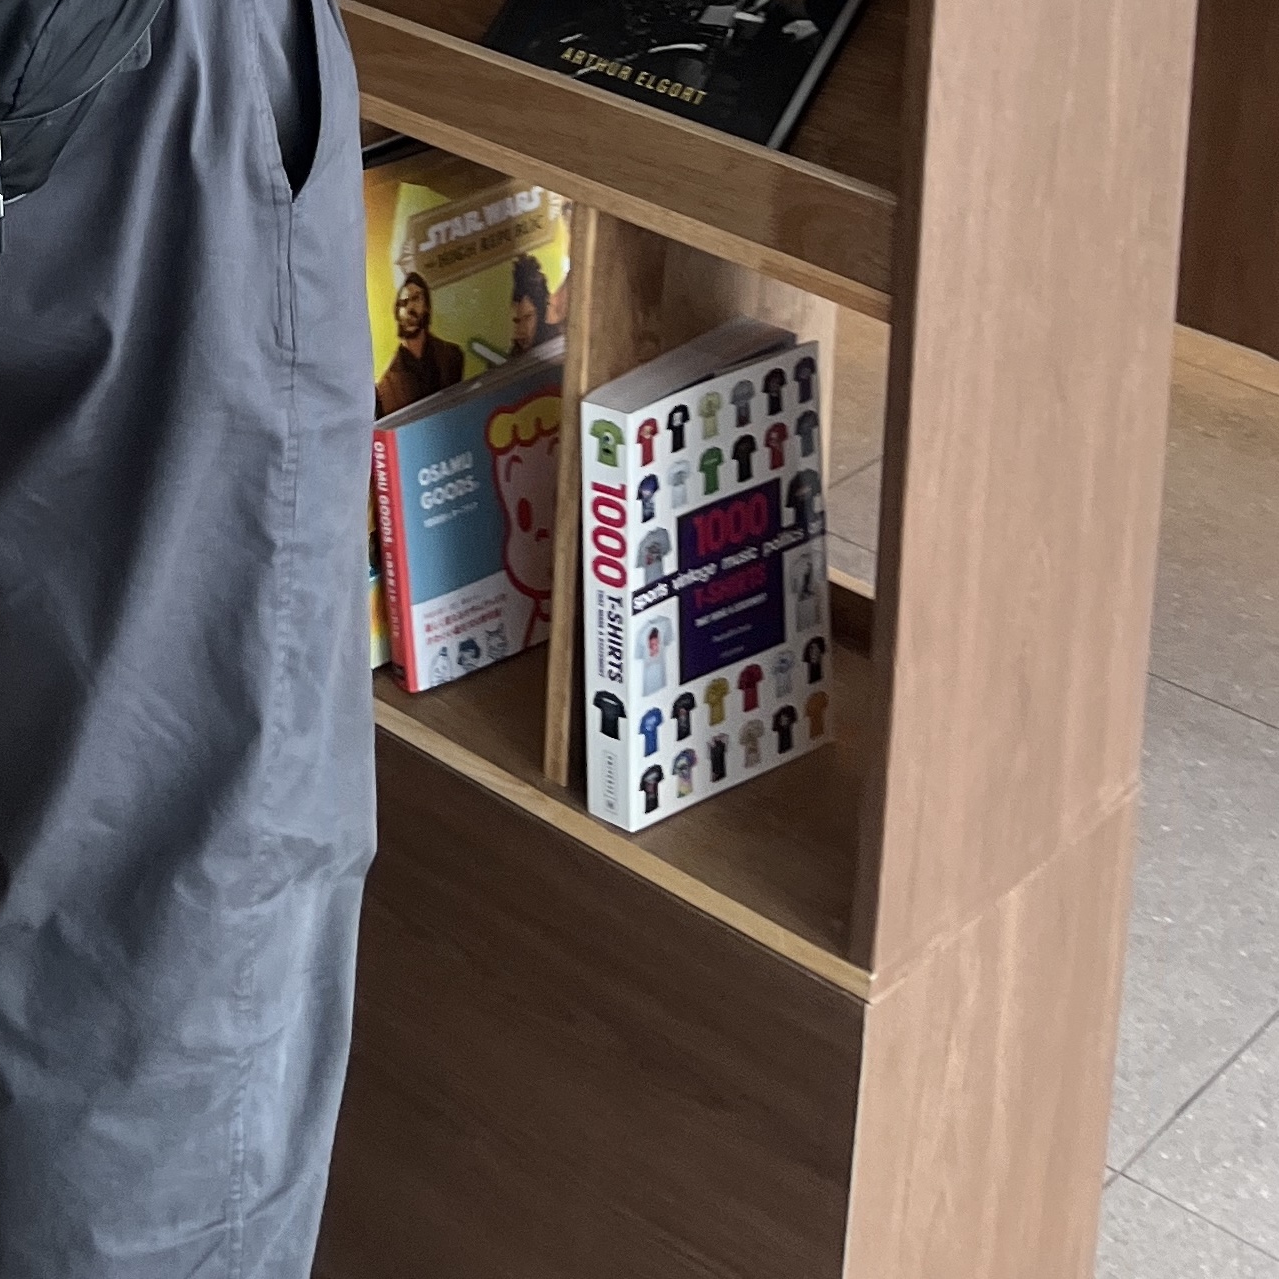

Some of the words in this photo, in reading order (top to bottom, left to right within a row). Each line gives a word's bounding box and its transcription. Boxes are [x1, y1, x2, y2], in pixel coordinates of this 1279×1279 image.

[560, 46, 633, 81] ARTHUR
[634, 71, 708, 106] ELGORT
[418, 210, 485, 252] STAR
[374, 440, 390, 491] OSAMU
[592, 481, 627, 589] 1000
[692, 492, 768, 557] 1000
[608, 594, 623, 684] T-SHIRTS
